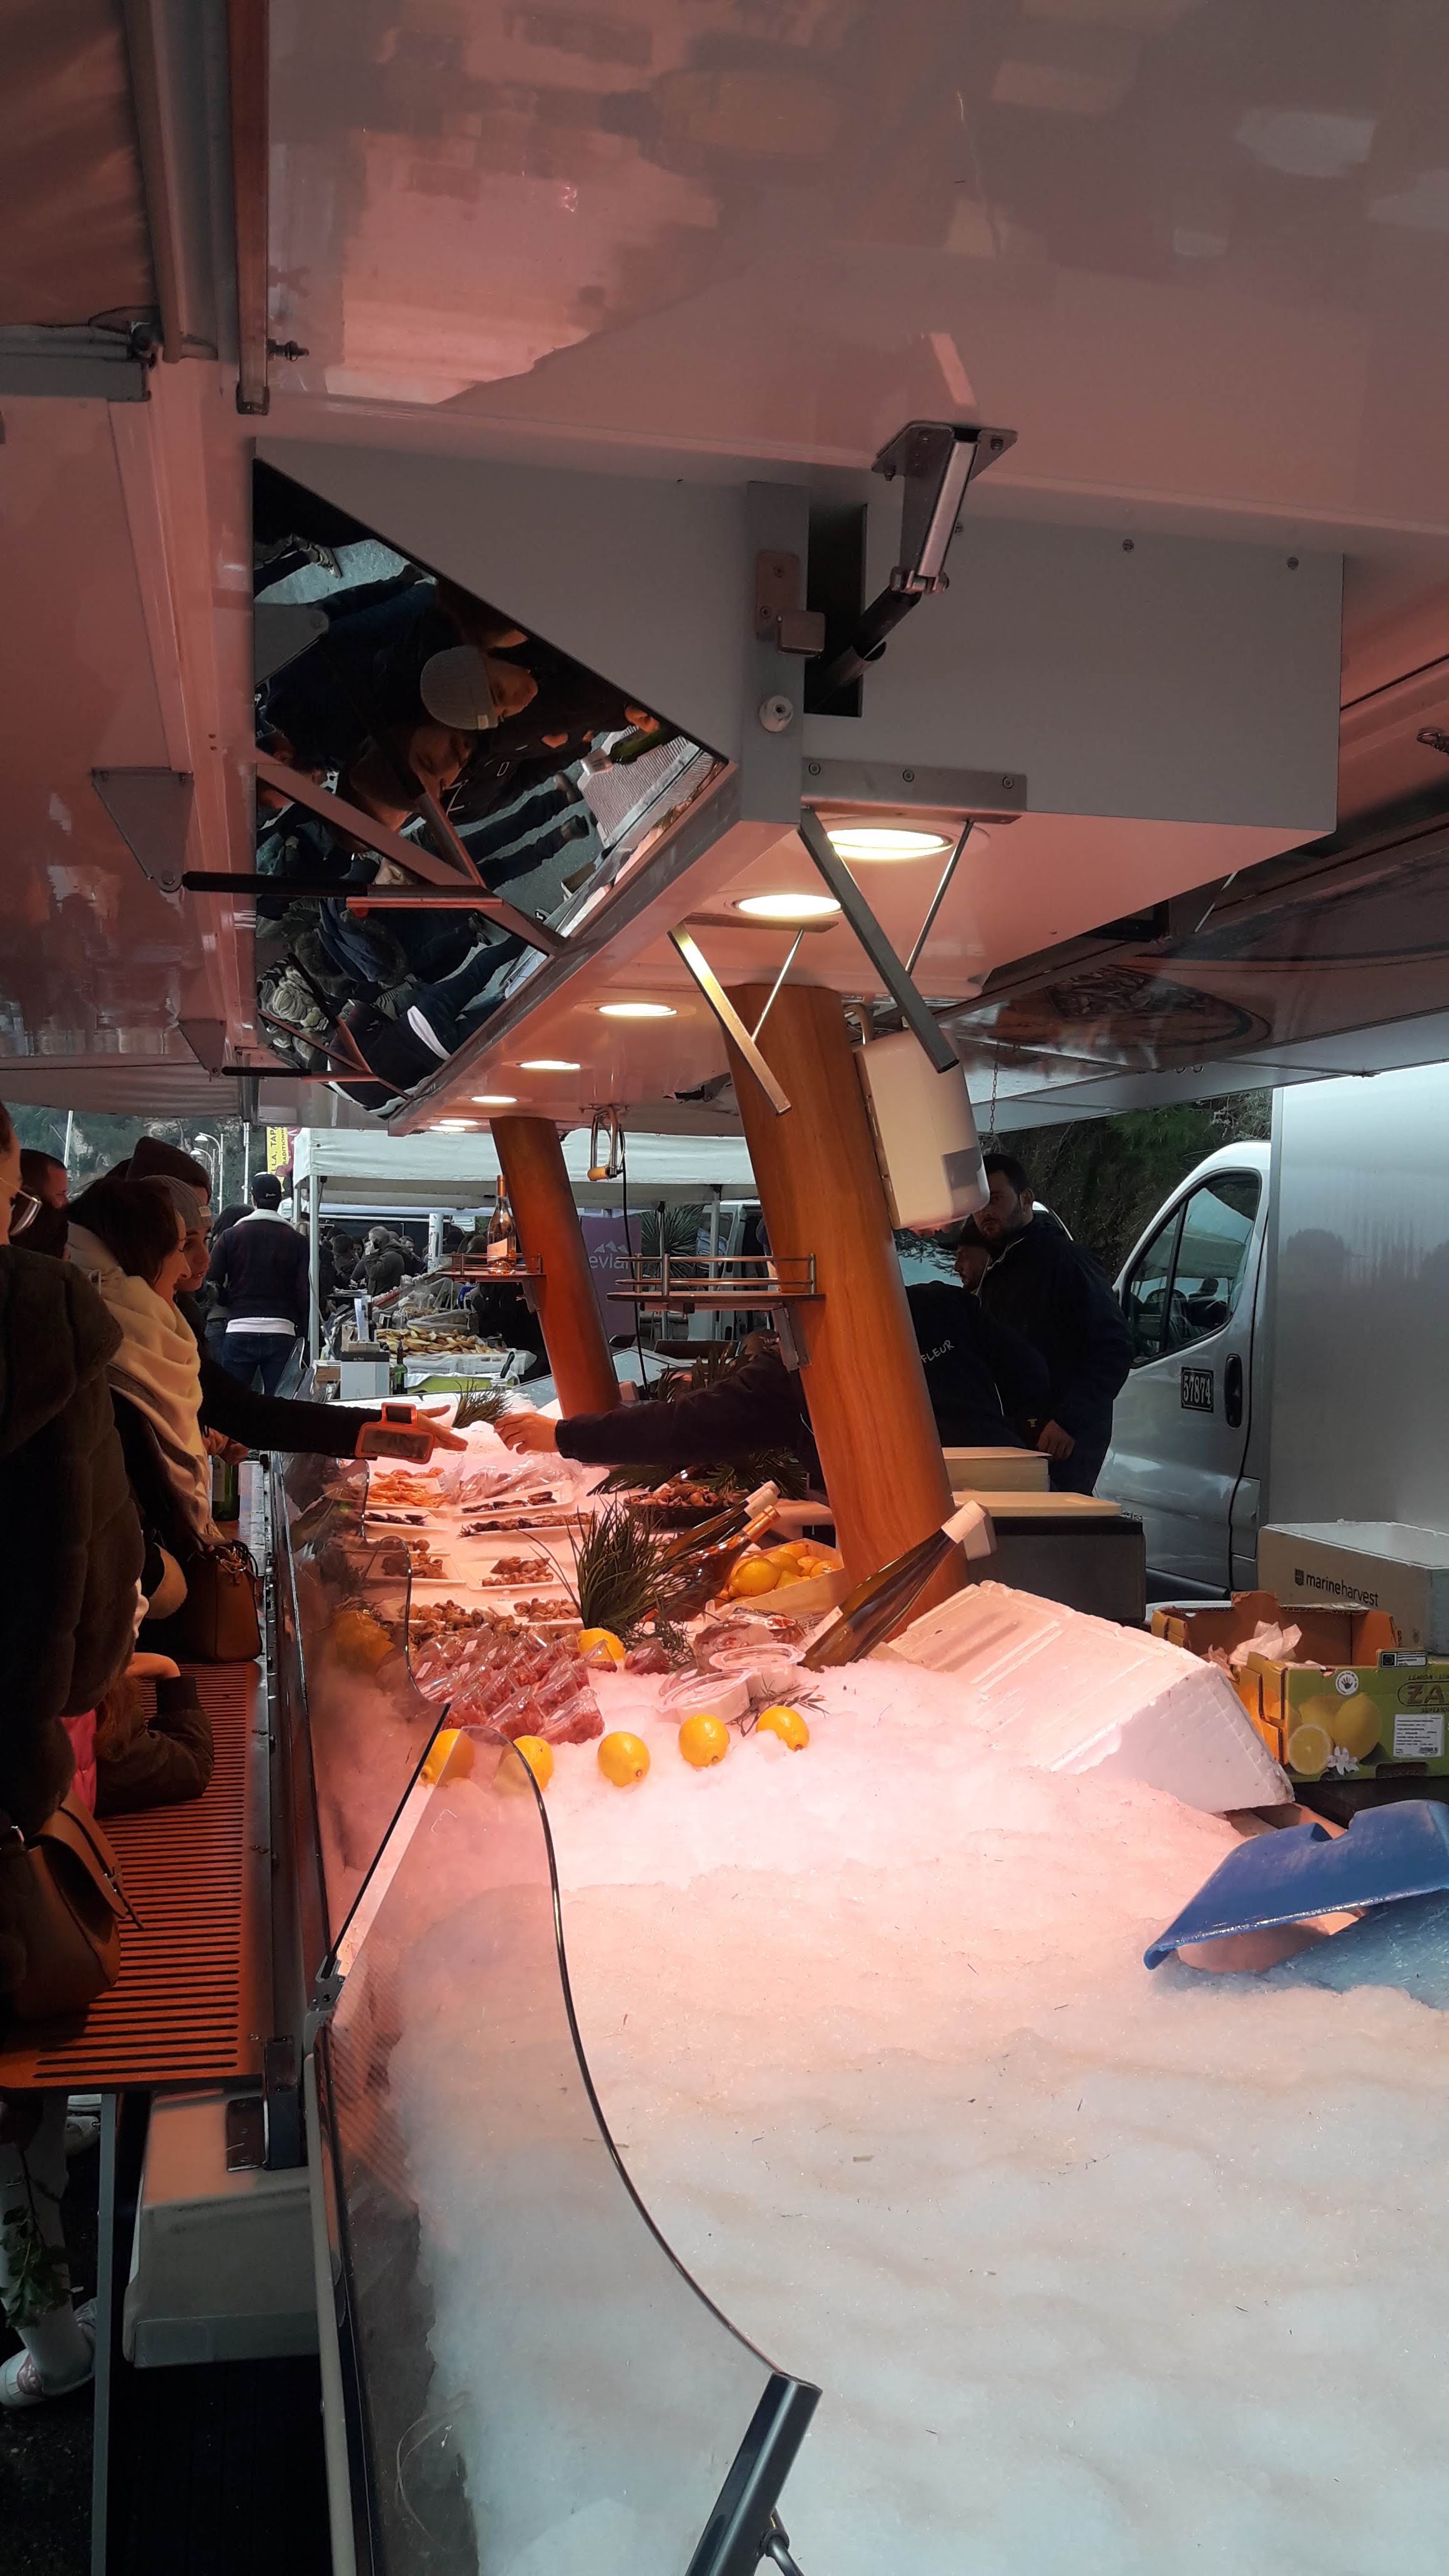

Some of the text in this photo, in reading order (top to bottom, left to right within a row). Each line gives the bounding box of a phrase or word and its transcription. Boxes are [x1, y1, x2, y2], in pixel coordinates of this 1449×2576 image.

[920, 1340, 954, 1363] FLEUR
[1183, 1375, 1211, 1405] 57874
[1306, 1574, 1378, 1607] marineharvest
